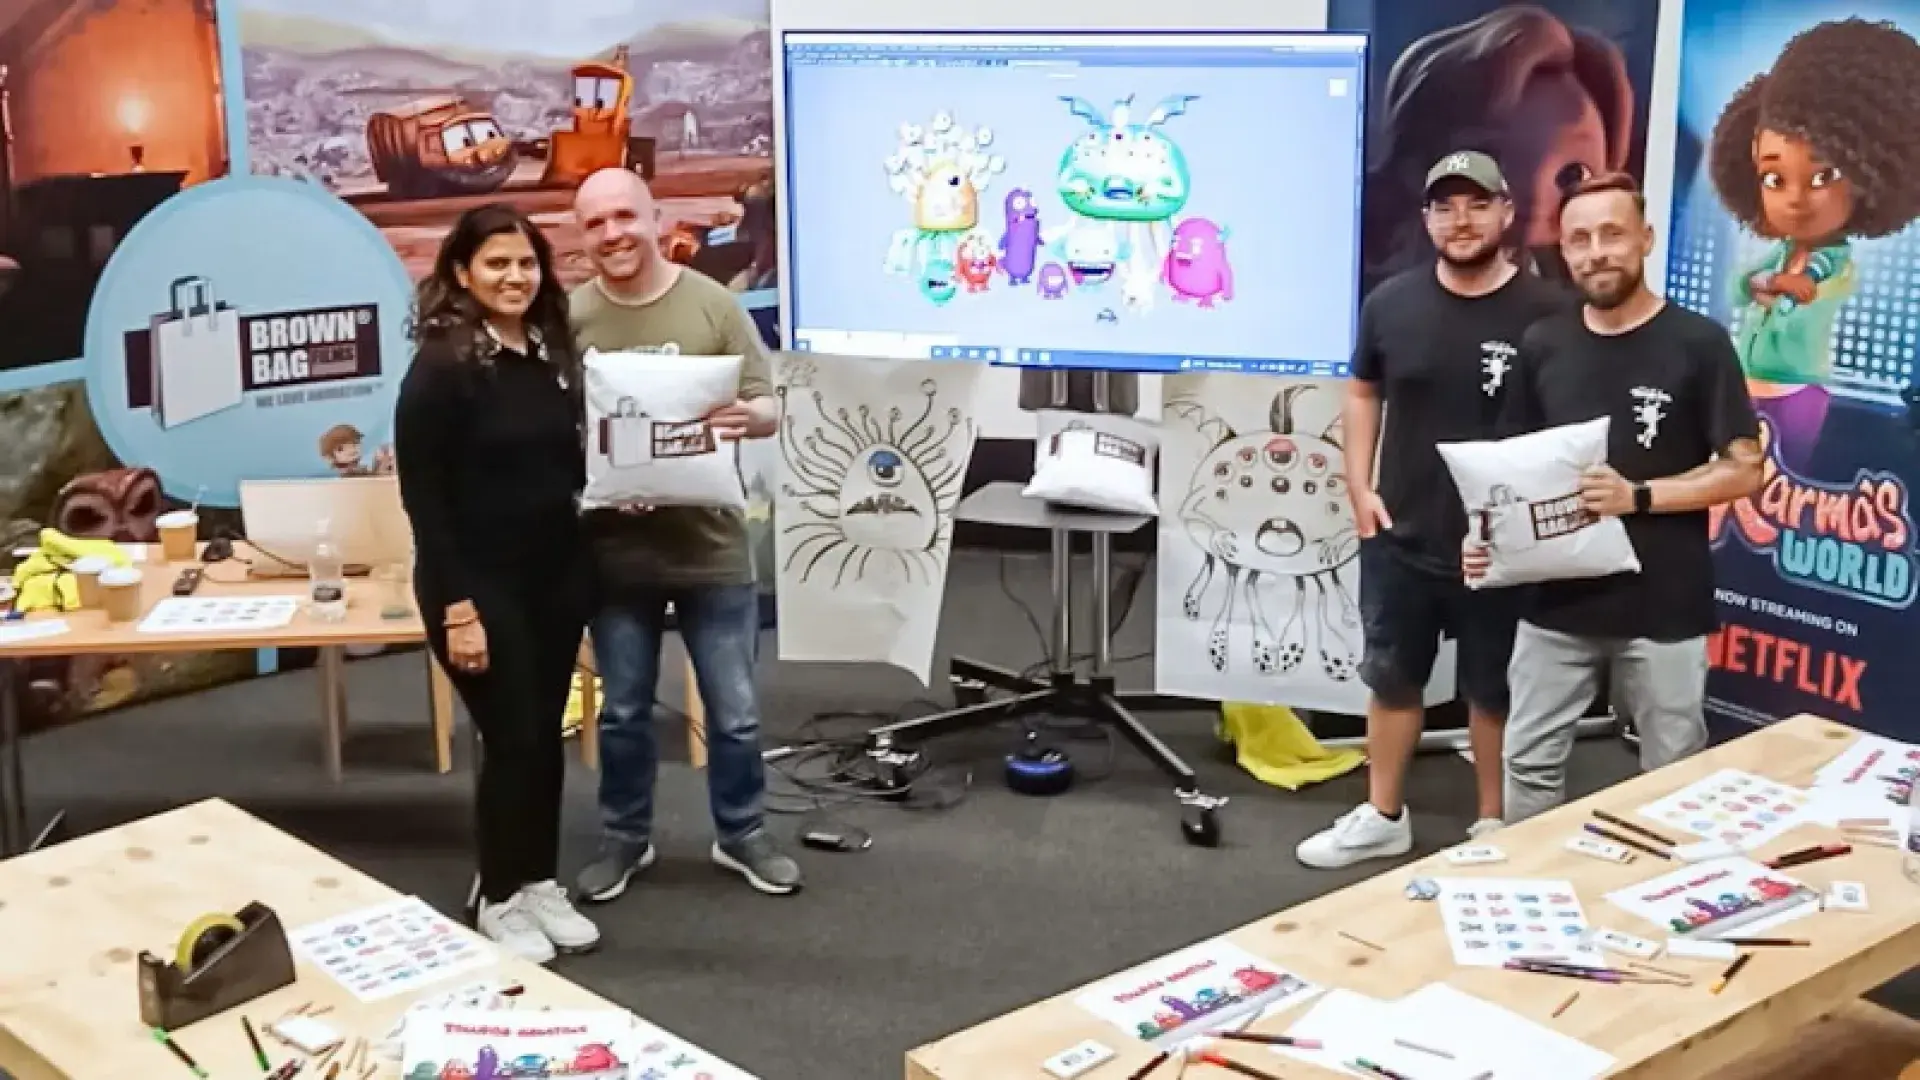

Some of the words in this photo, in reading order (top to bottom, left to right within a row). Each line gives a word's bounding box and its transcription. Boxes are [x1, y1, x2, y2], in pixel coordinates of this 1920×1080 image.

[250, 311, 356, 350] BROWN
[251, 350, 308, 384] BAG
[1780, 528, 1909, 599] WORLD
[1714, 588, 1748, 607] NOW
[1751, 597, 1832, 630] STREAMING
[1835, 618, 1858, 637] ON
[1707, 622, 1867, 711] NETFLIX
